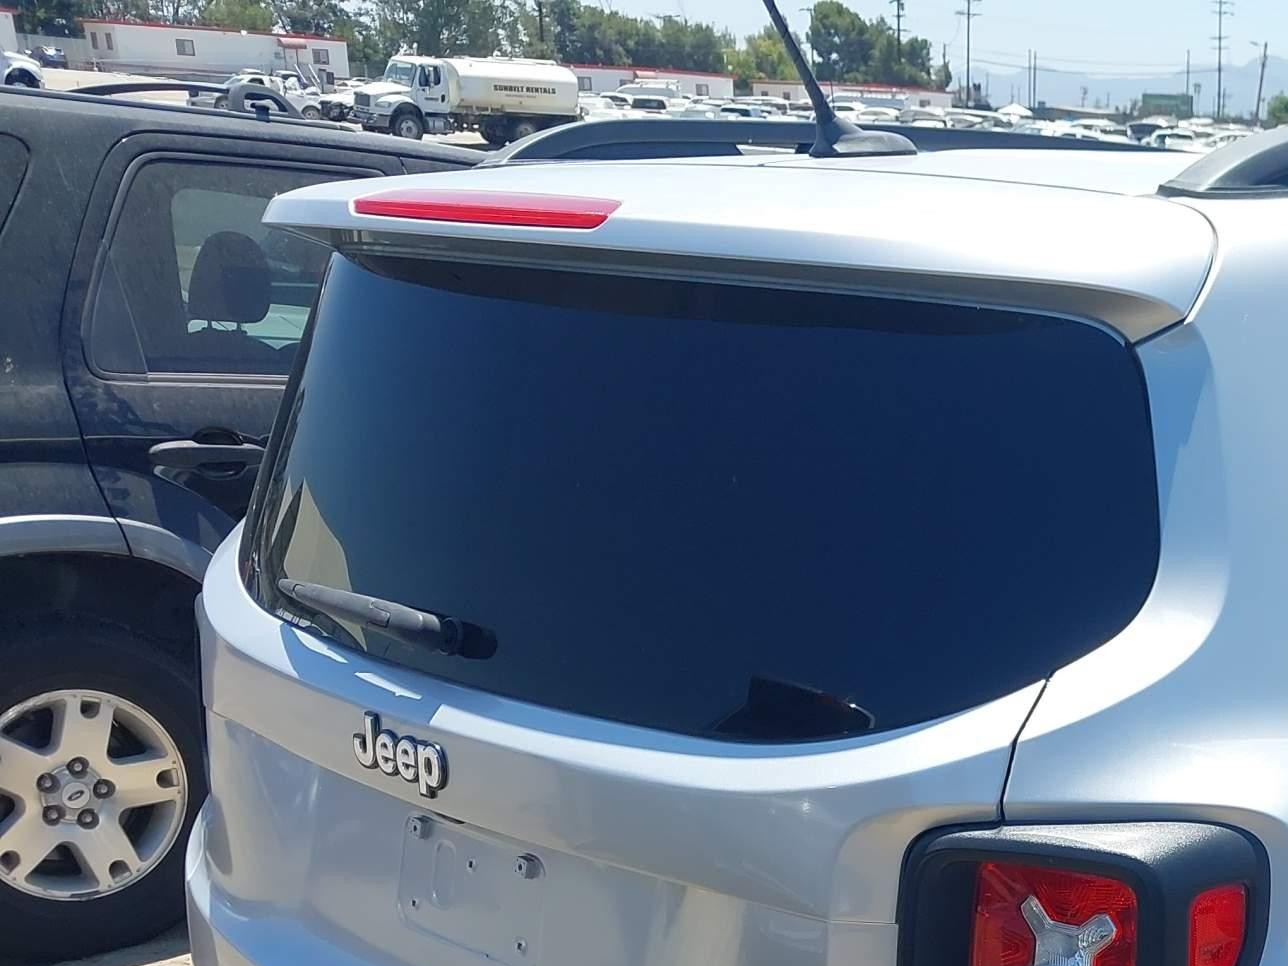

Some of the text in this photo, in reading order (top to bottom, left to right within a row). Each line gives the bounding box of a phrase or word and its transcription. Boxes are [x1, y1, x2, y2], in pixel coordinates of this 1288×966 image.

[493, 84, 556, 95] SUNBELT RENTALS
[353, 709, 449, 799] Jeep
